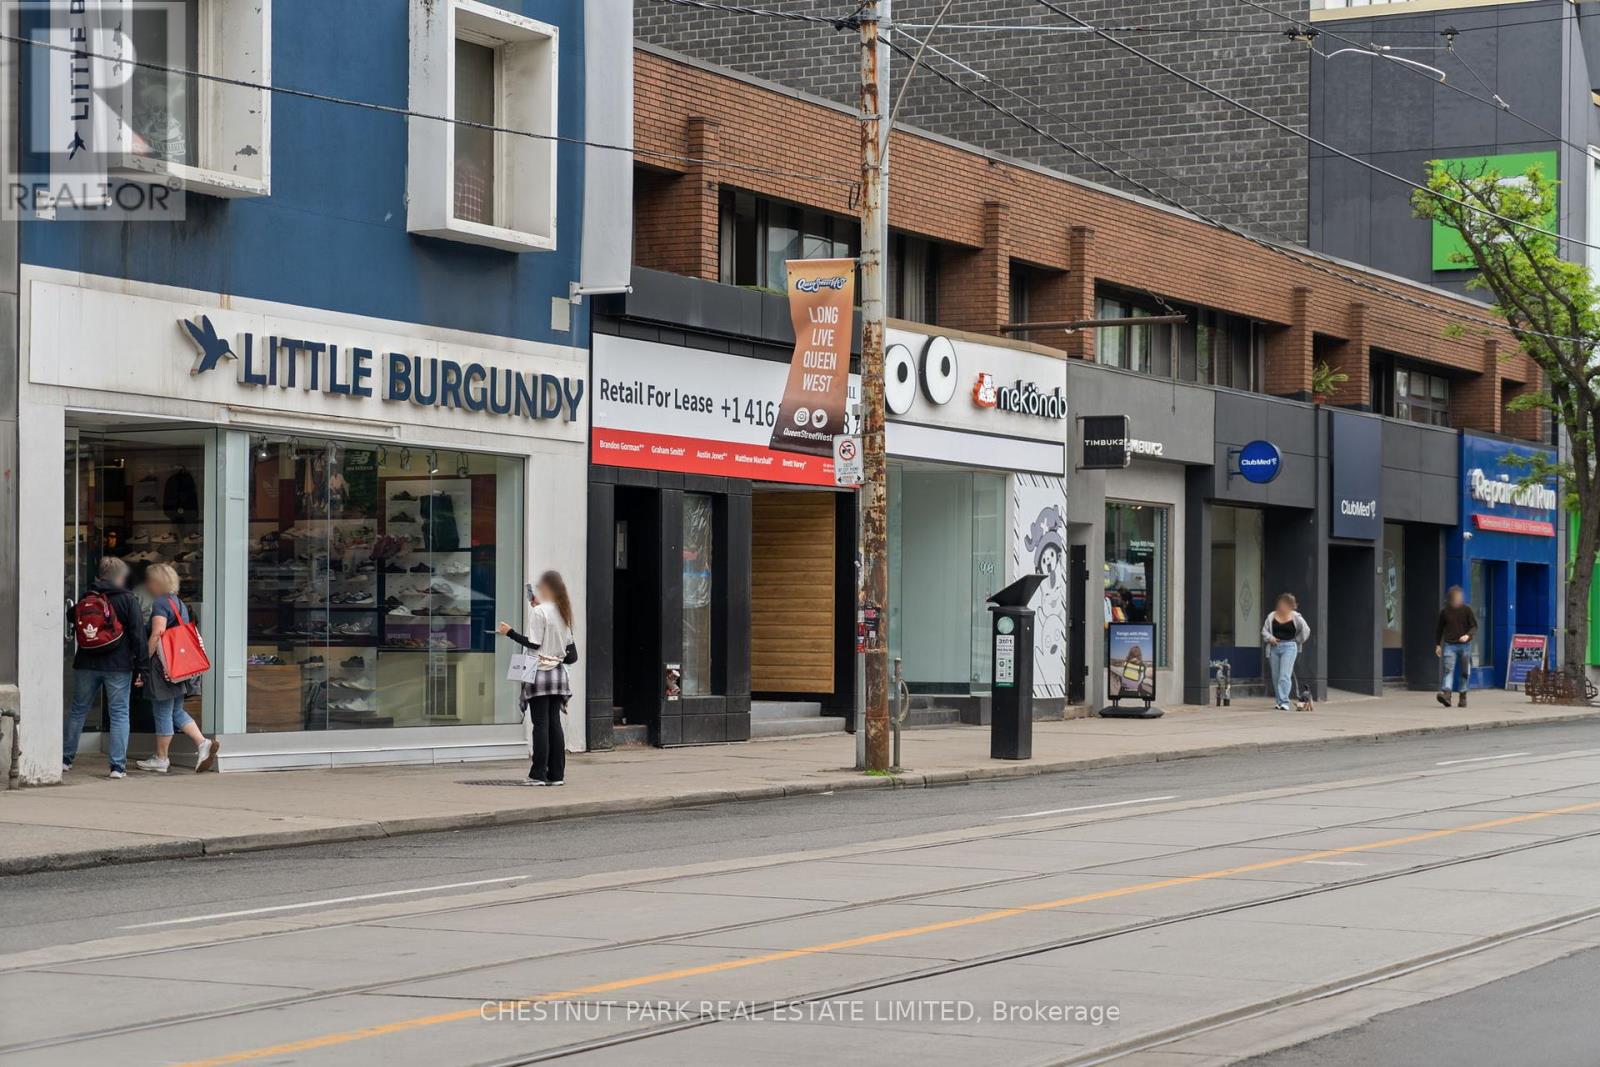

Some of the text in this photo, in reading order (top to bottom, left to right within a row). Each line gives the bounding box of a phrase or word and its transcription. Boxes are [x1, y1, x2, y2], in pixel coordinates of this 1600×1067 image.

[70, 26, 89, 121] LITTLE
[808, 306, 839, 324] LONG
[811, 328, 835, 347] LIVE
[803, 350, 837, 370] QUEEN
[238, 332, 584, 422] LITTLE BURGUNDY
[802, 373, 832, 393] WEST
[600, 378, 643, 405] Retail
[647, 384, 671, 408] For
[674, 388, 713, 414] Lease
[744, 398, 775, 428] 416
[1084, 439, 1124, 447] TIMBUK2
